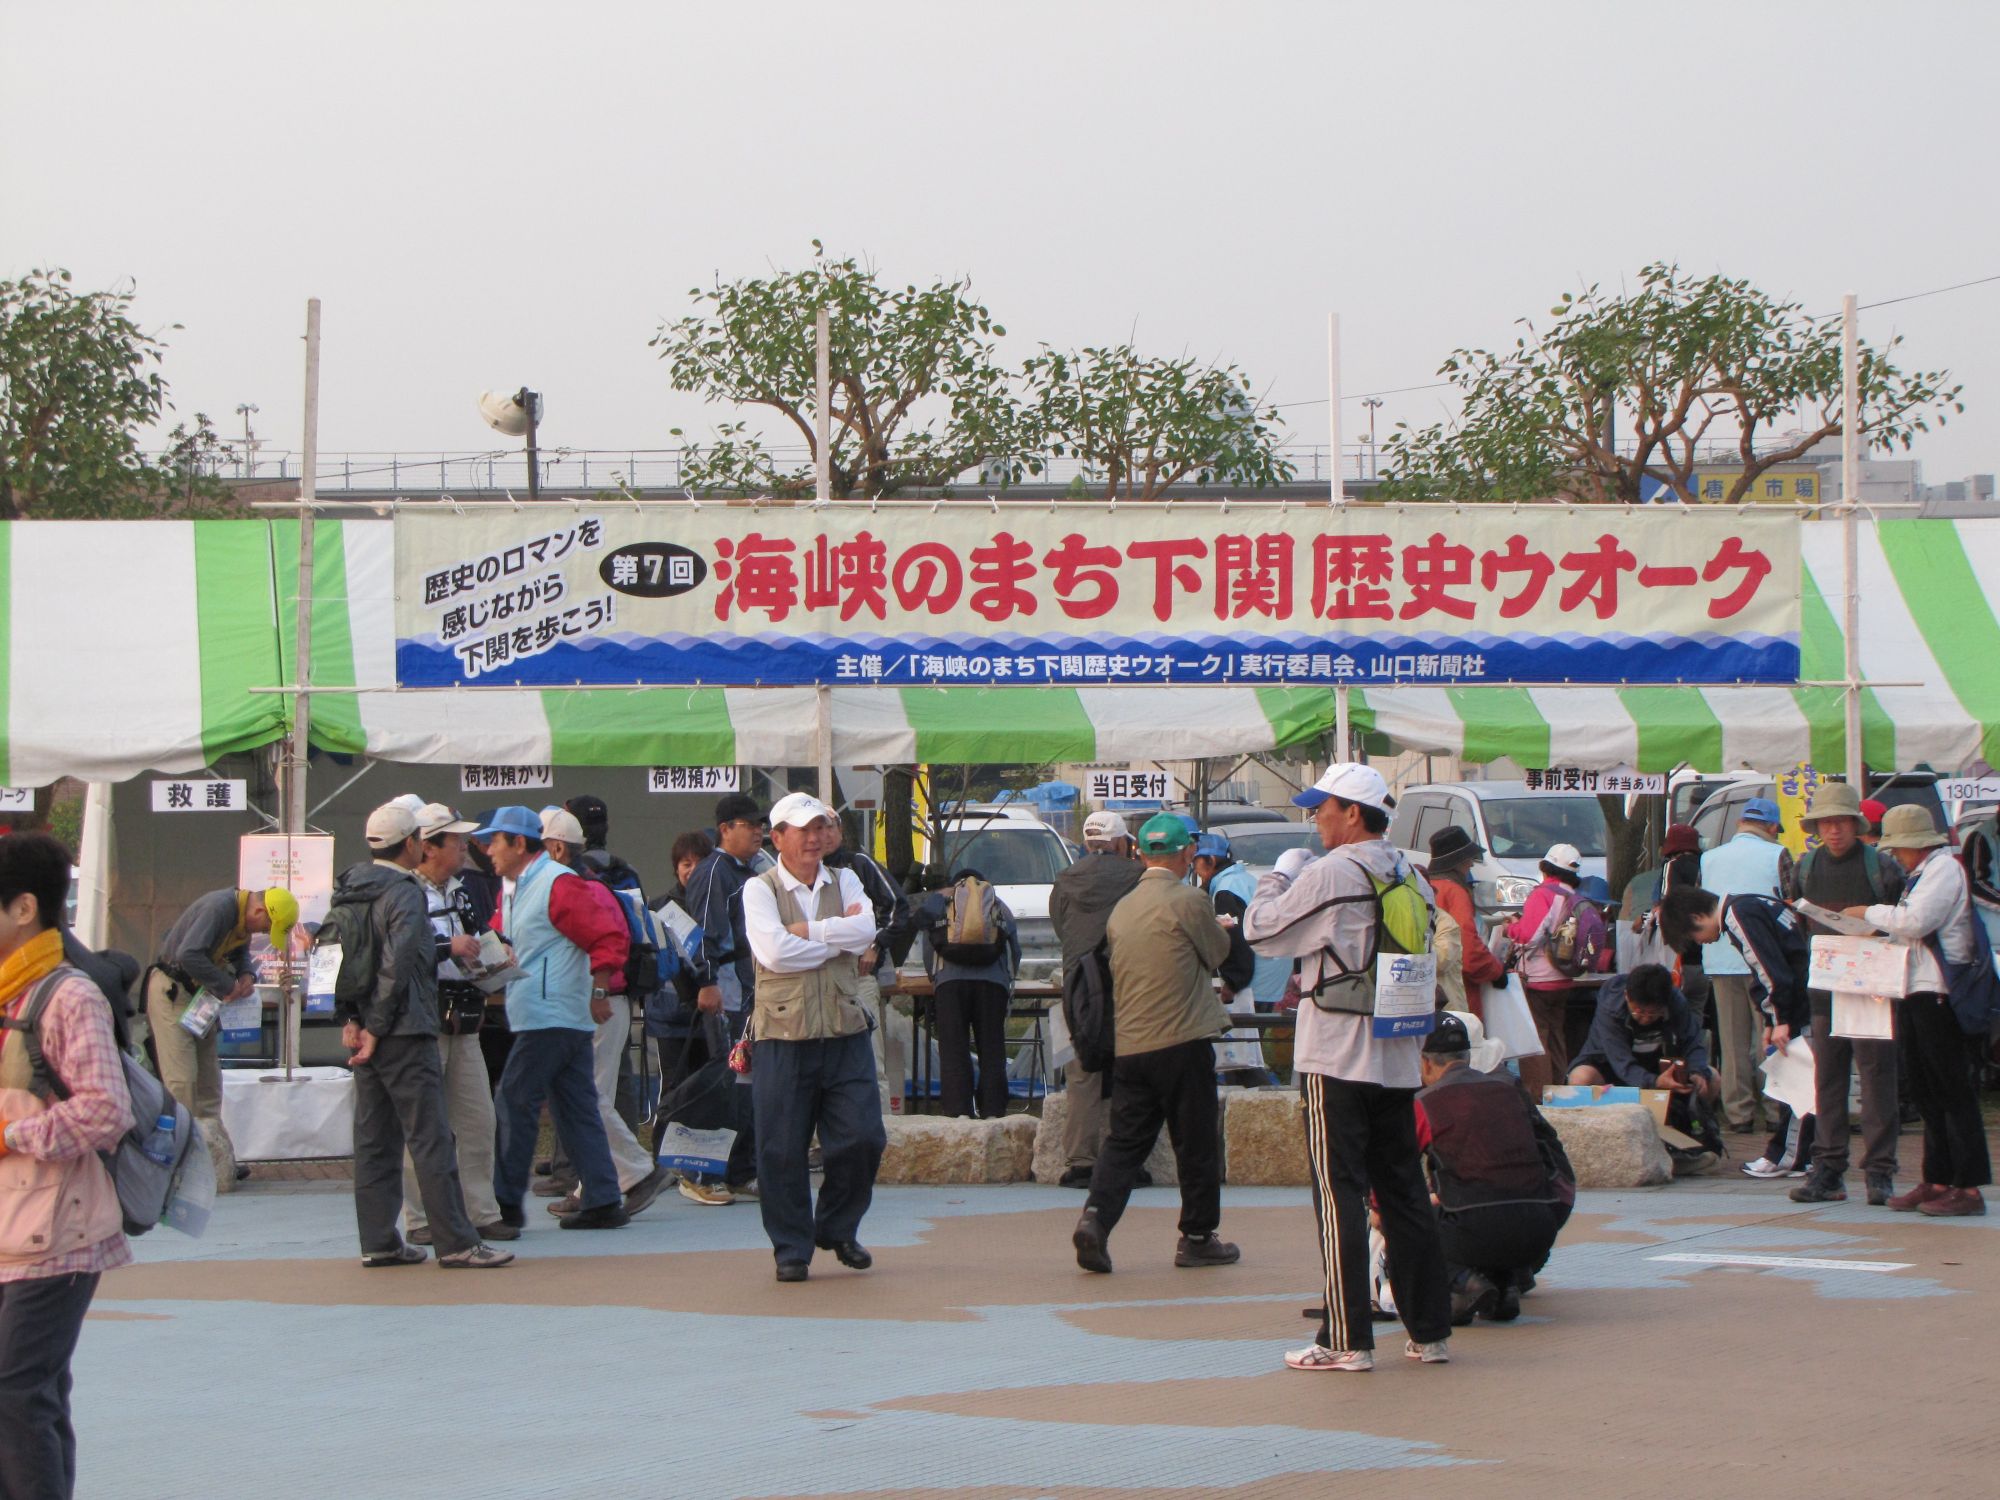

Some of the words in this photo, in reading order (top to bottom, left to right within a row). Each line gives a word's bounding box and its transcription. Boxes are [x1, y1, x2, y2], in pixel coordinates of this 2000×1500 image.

[1705, 478, 1814, 499] 唐市場
[424, 518, 601, 605] 歴史のロマンを
[611, 554, 695, 587] 第7回
[713, 529, 1773, 622] 海峡のまち下関歴史ウオーク
[441, 572, 565, 641] 感じながら
[459, 594, 613, 674] 下関を歩こう!
[464, 765, 550, 788] 荷物預かり
[652, 766, 738, 789] 荷物預かり
[1093, 773, 1167, 798] 当日受付
[167, 783, 232, 808] 救護
